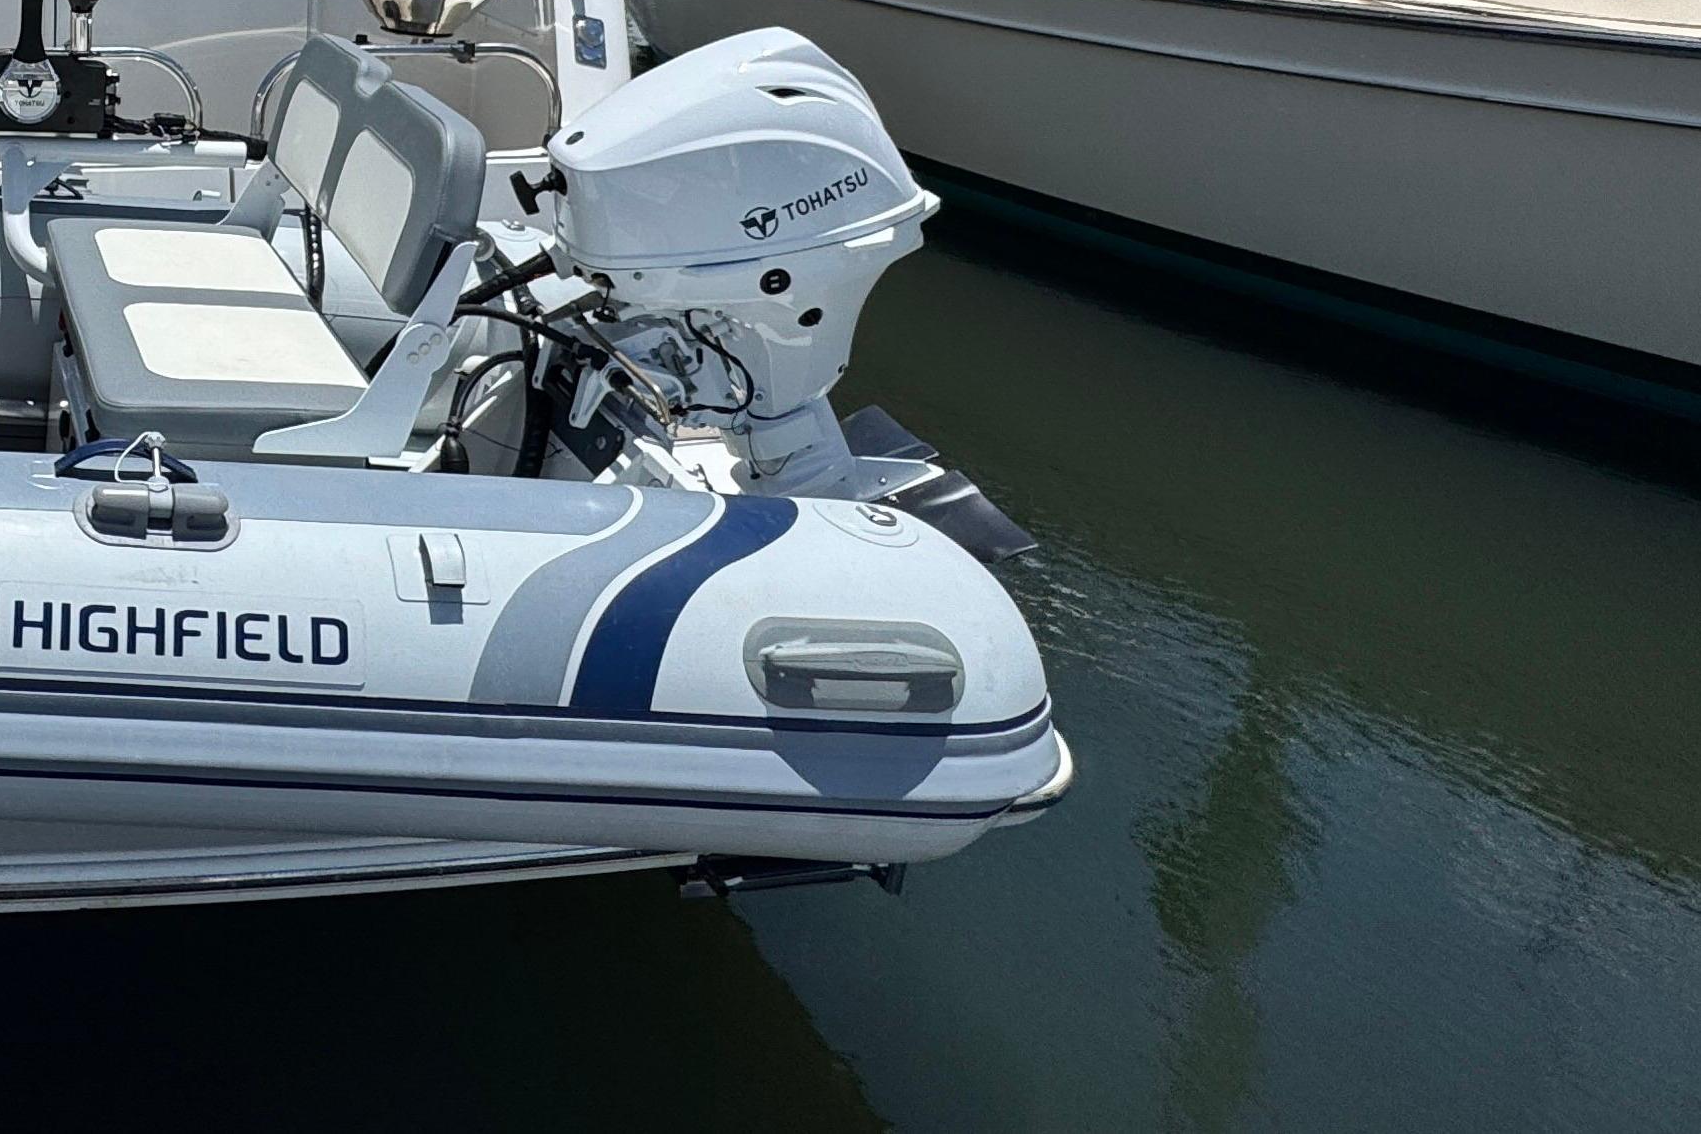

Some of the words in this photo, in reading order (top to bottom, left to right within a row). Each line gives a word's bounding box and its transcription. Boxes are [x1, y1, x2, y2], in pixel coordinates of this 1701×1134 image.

[14, 99, 45, 107] TOHATSU
[781, 168, 869, 220] TOHATSU
[12, 600, 349, 666] HIGHFIELD
